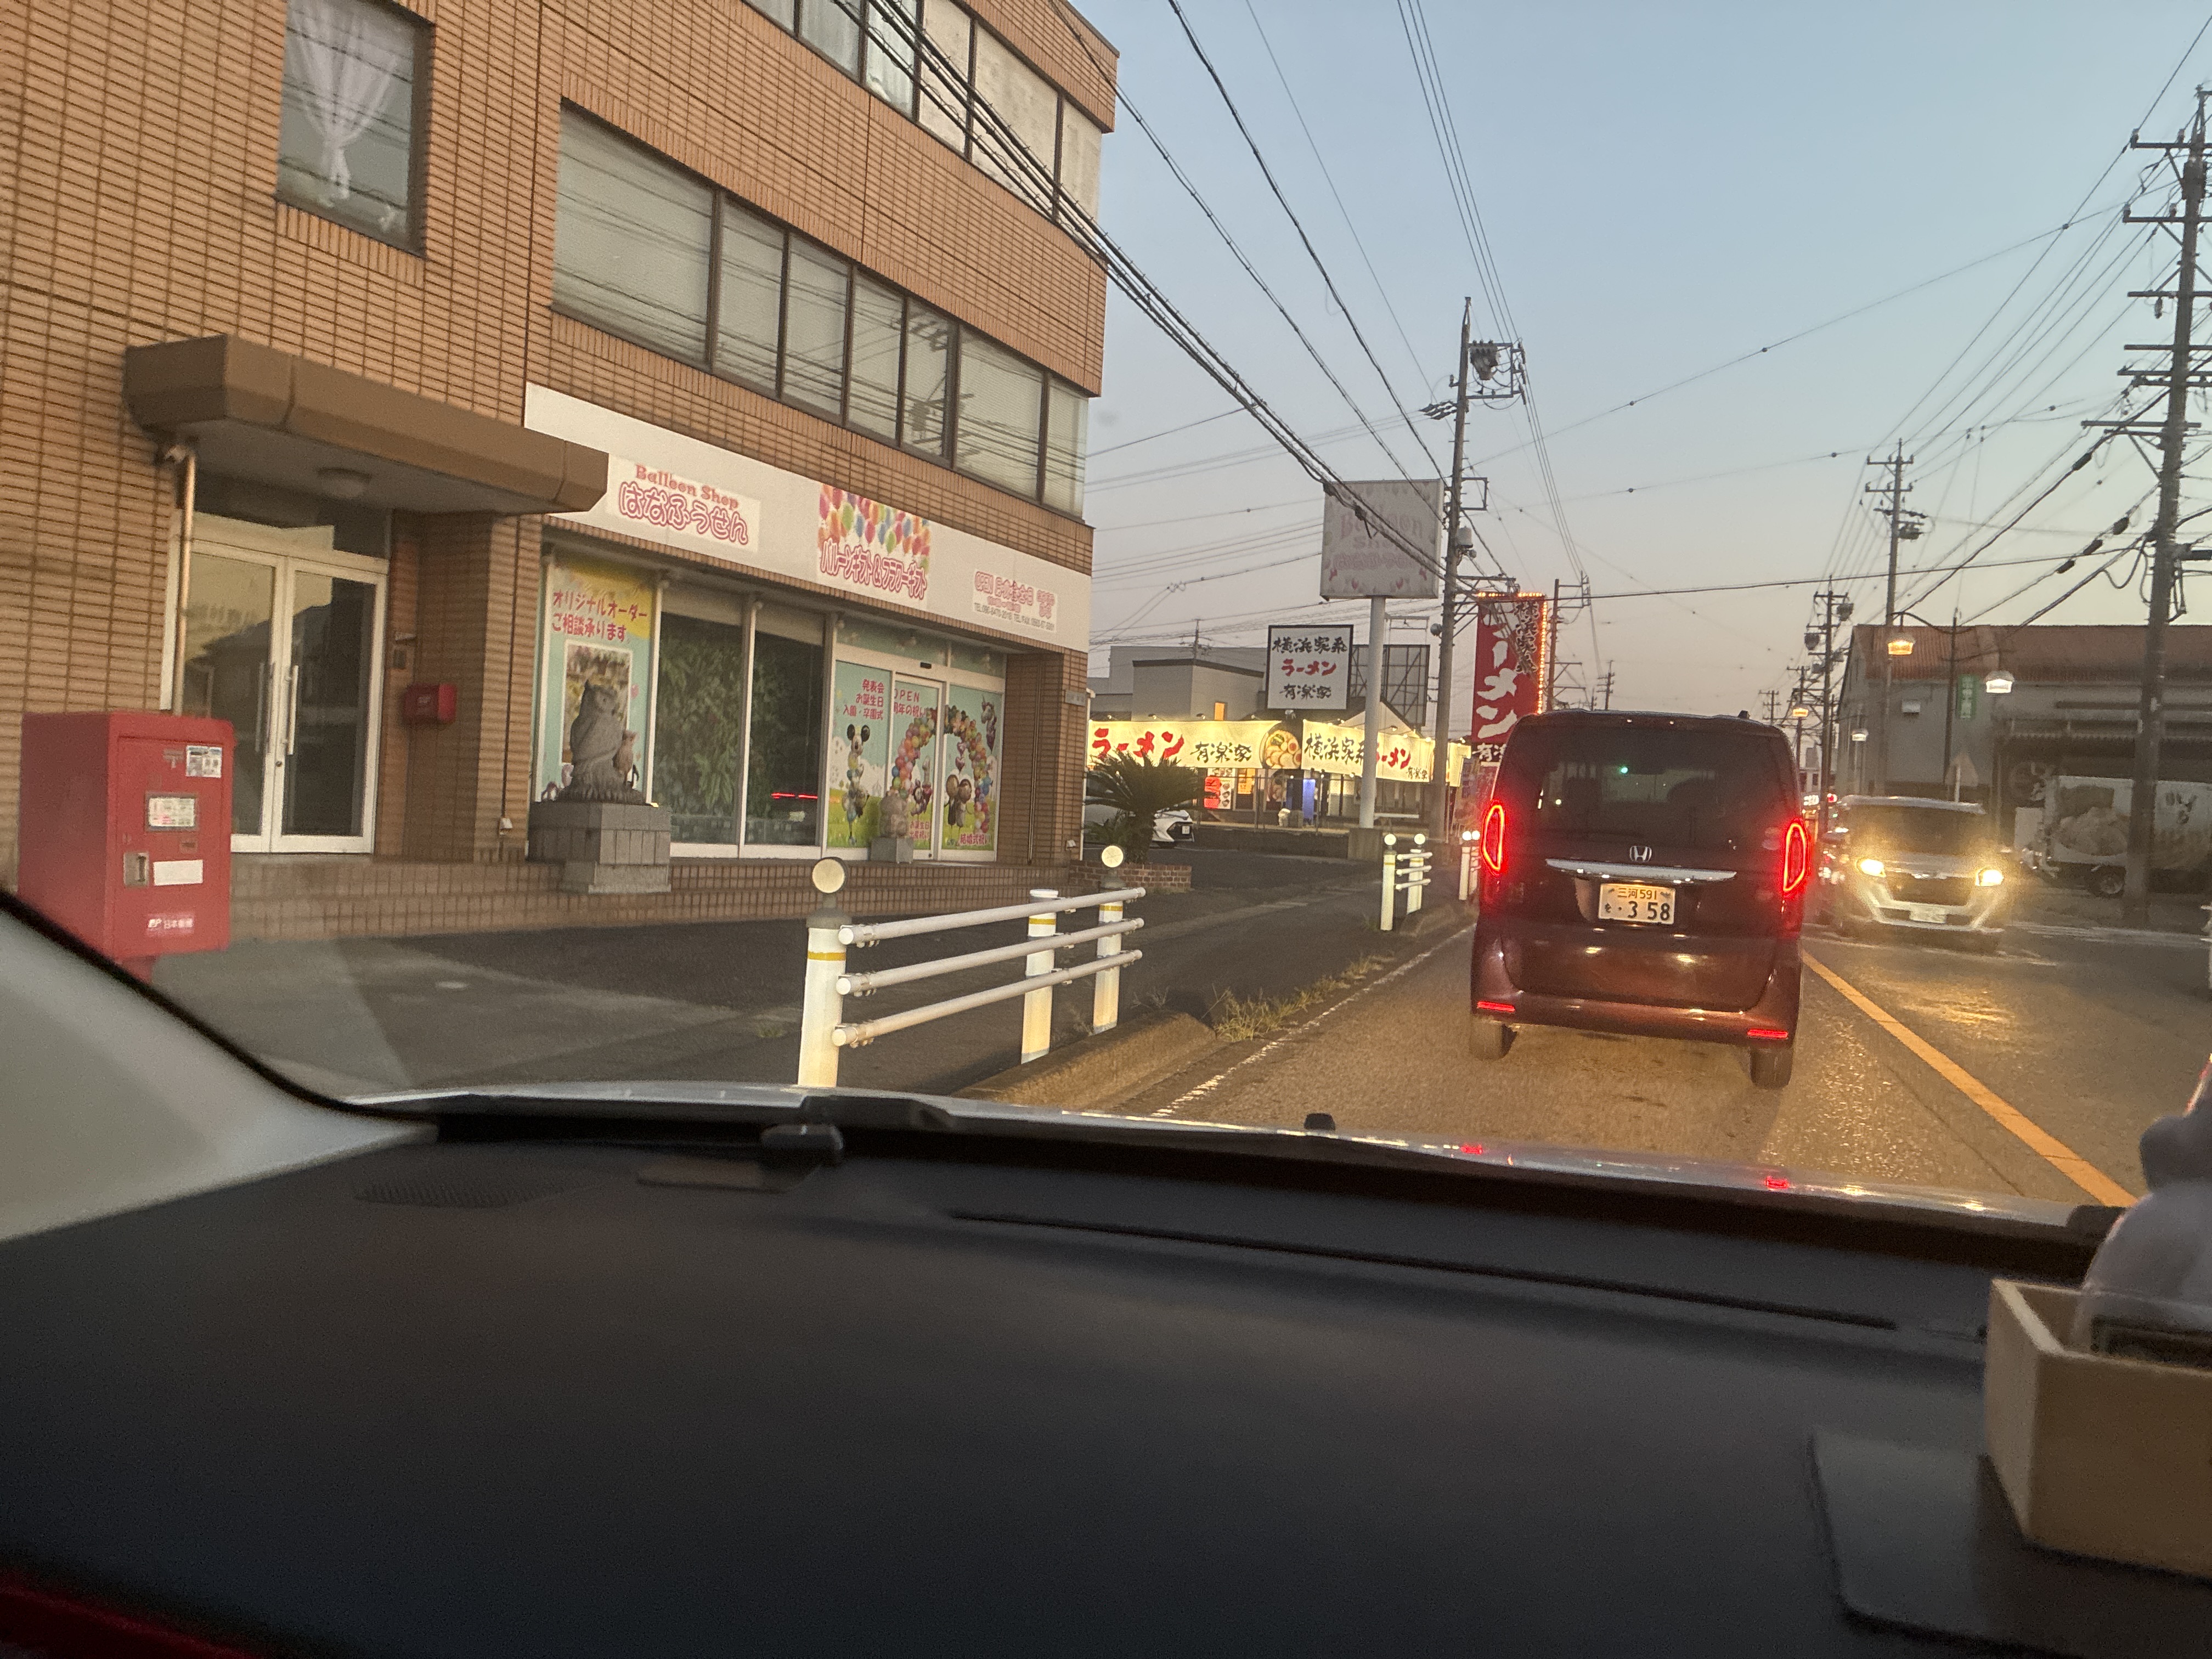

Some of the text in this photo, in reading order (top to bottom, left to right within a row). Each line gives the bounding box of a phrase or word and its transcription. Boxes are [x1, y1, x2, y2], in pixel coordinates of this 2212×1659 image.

[635, 463, 740, 511] Balloon Shop
[618, 481, 749, 545] はなふうせん
[552, 589, 648, 621] オリジナルオーダー
[1272, 636, 1347, 654] 横浜家系
[1281, 658, 1337, 676] ラーメン
[862, 679, 884, 694] 発表会
[1279, 684, 1331, 700] 有楽家
[856, 693, 884, 708] お誕生日
[1092, 727, 1252, 763] ラーメン 有楽家
[1376, 742, 1411, 769] ーメン
